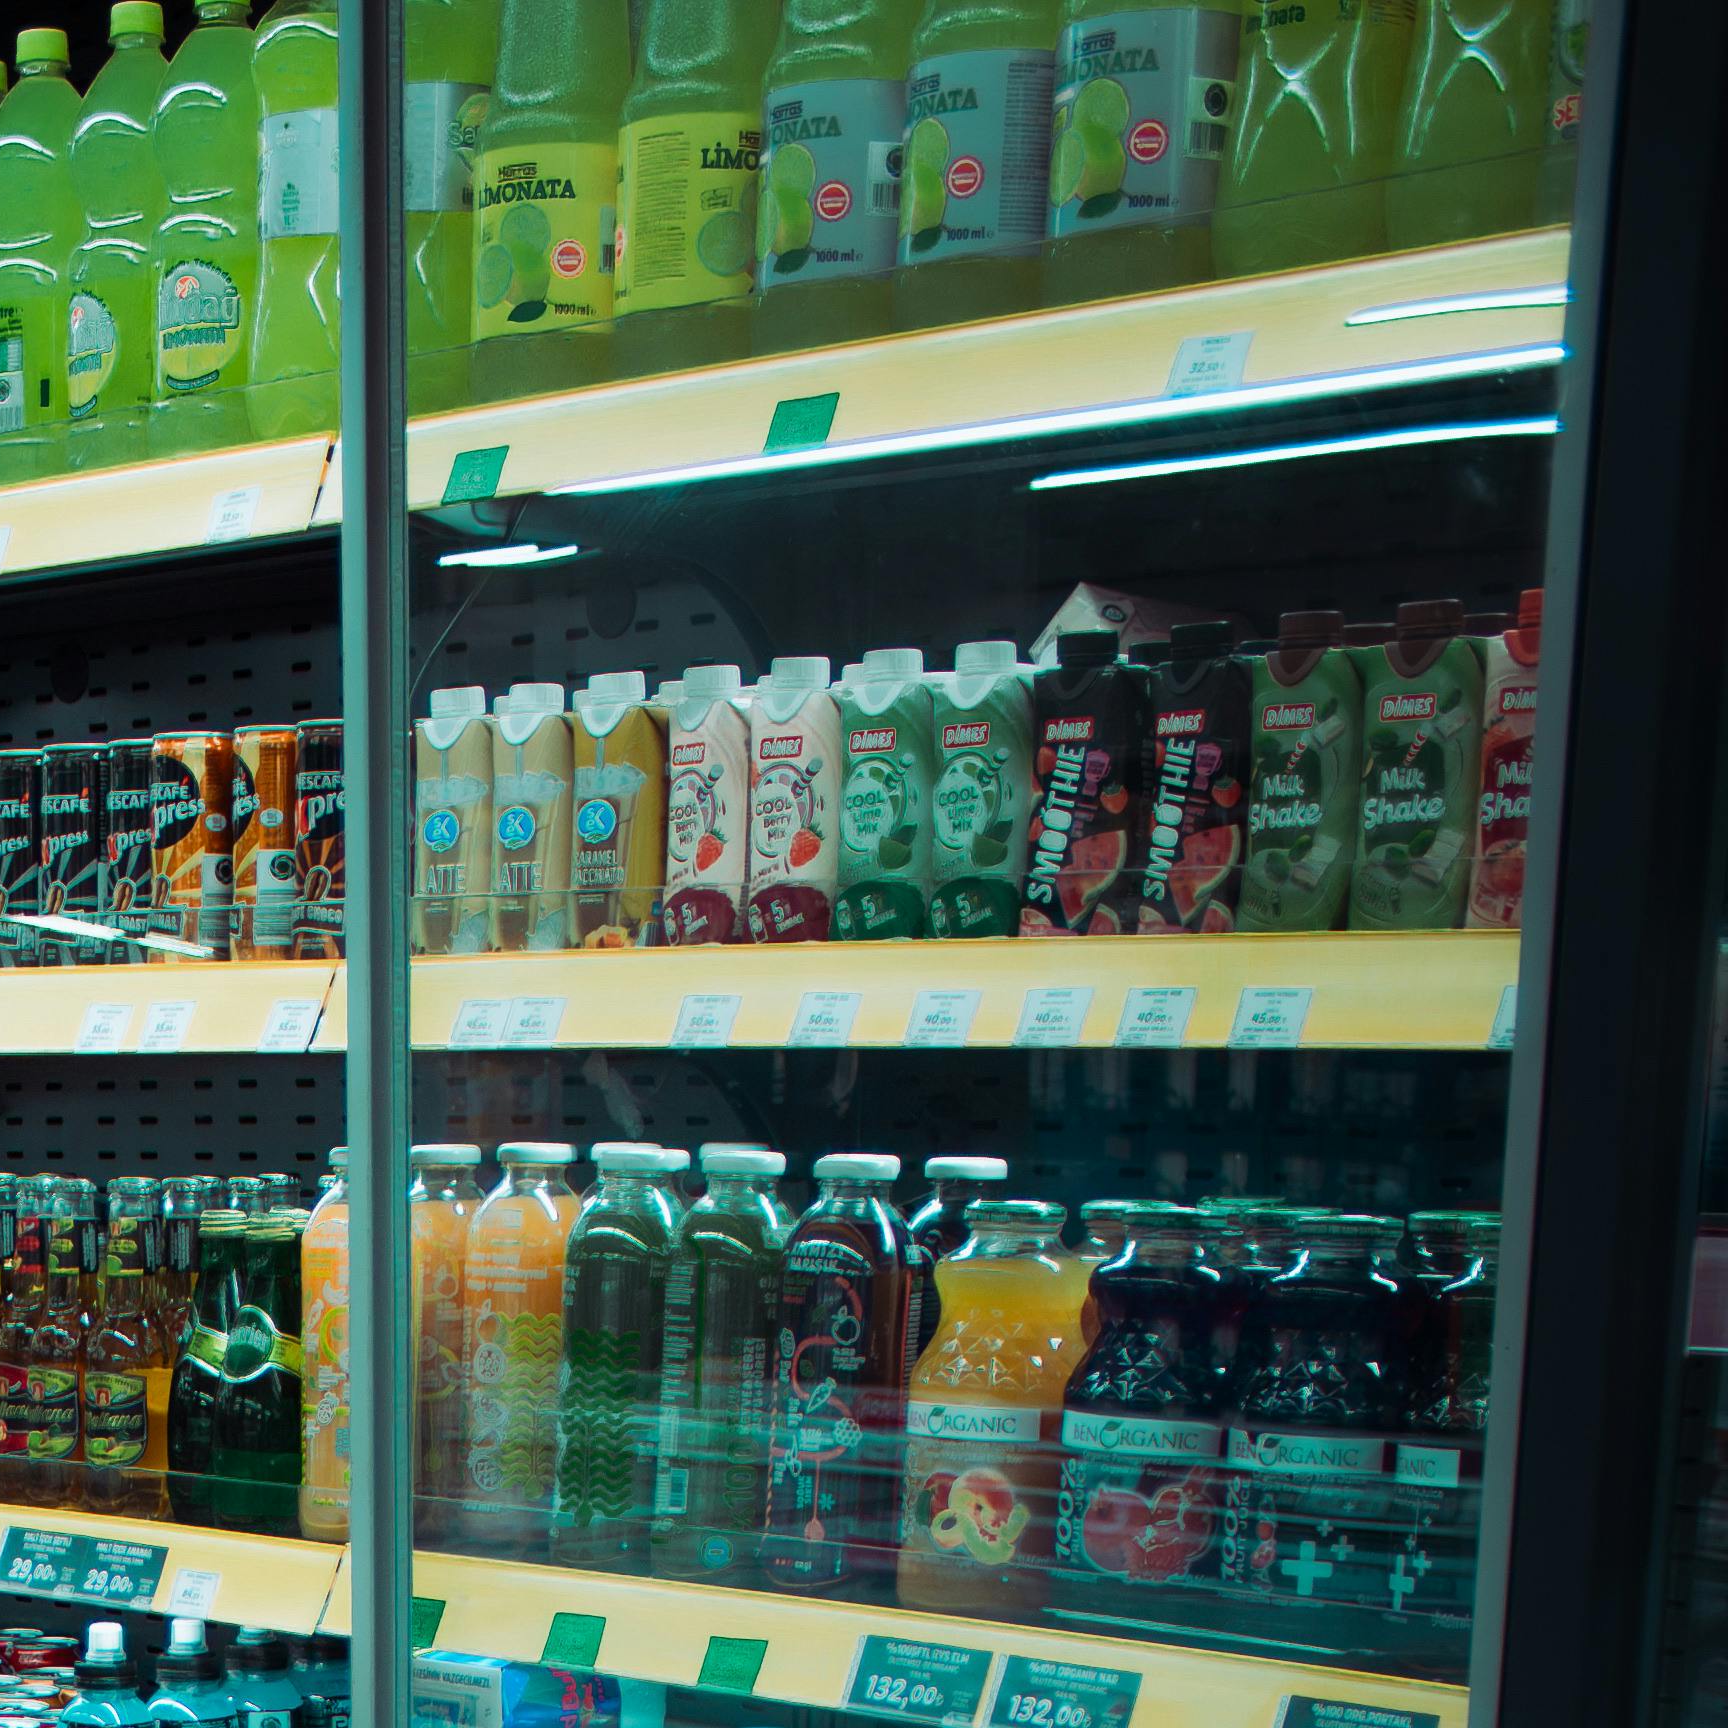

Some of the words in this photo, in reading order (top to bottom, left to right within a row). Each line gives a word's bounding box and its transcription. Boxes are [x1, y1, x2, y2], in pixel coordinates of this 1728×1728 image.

[946, 228, 969, 240] 1000
[1262, 774, 1305, 799] Milk
[1379, 767, 1425, 793] Milk
[755, 799, 792, 813] COOL
[1142, 737, 1196, 901] SMOOTHIE
[1248, 800, 1323, 834] Shake
[1363, 793, 1445, 830] Shake
[1027, 744, 1085, 904] SMOOTHIE
